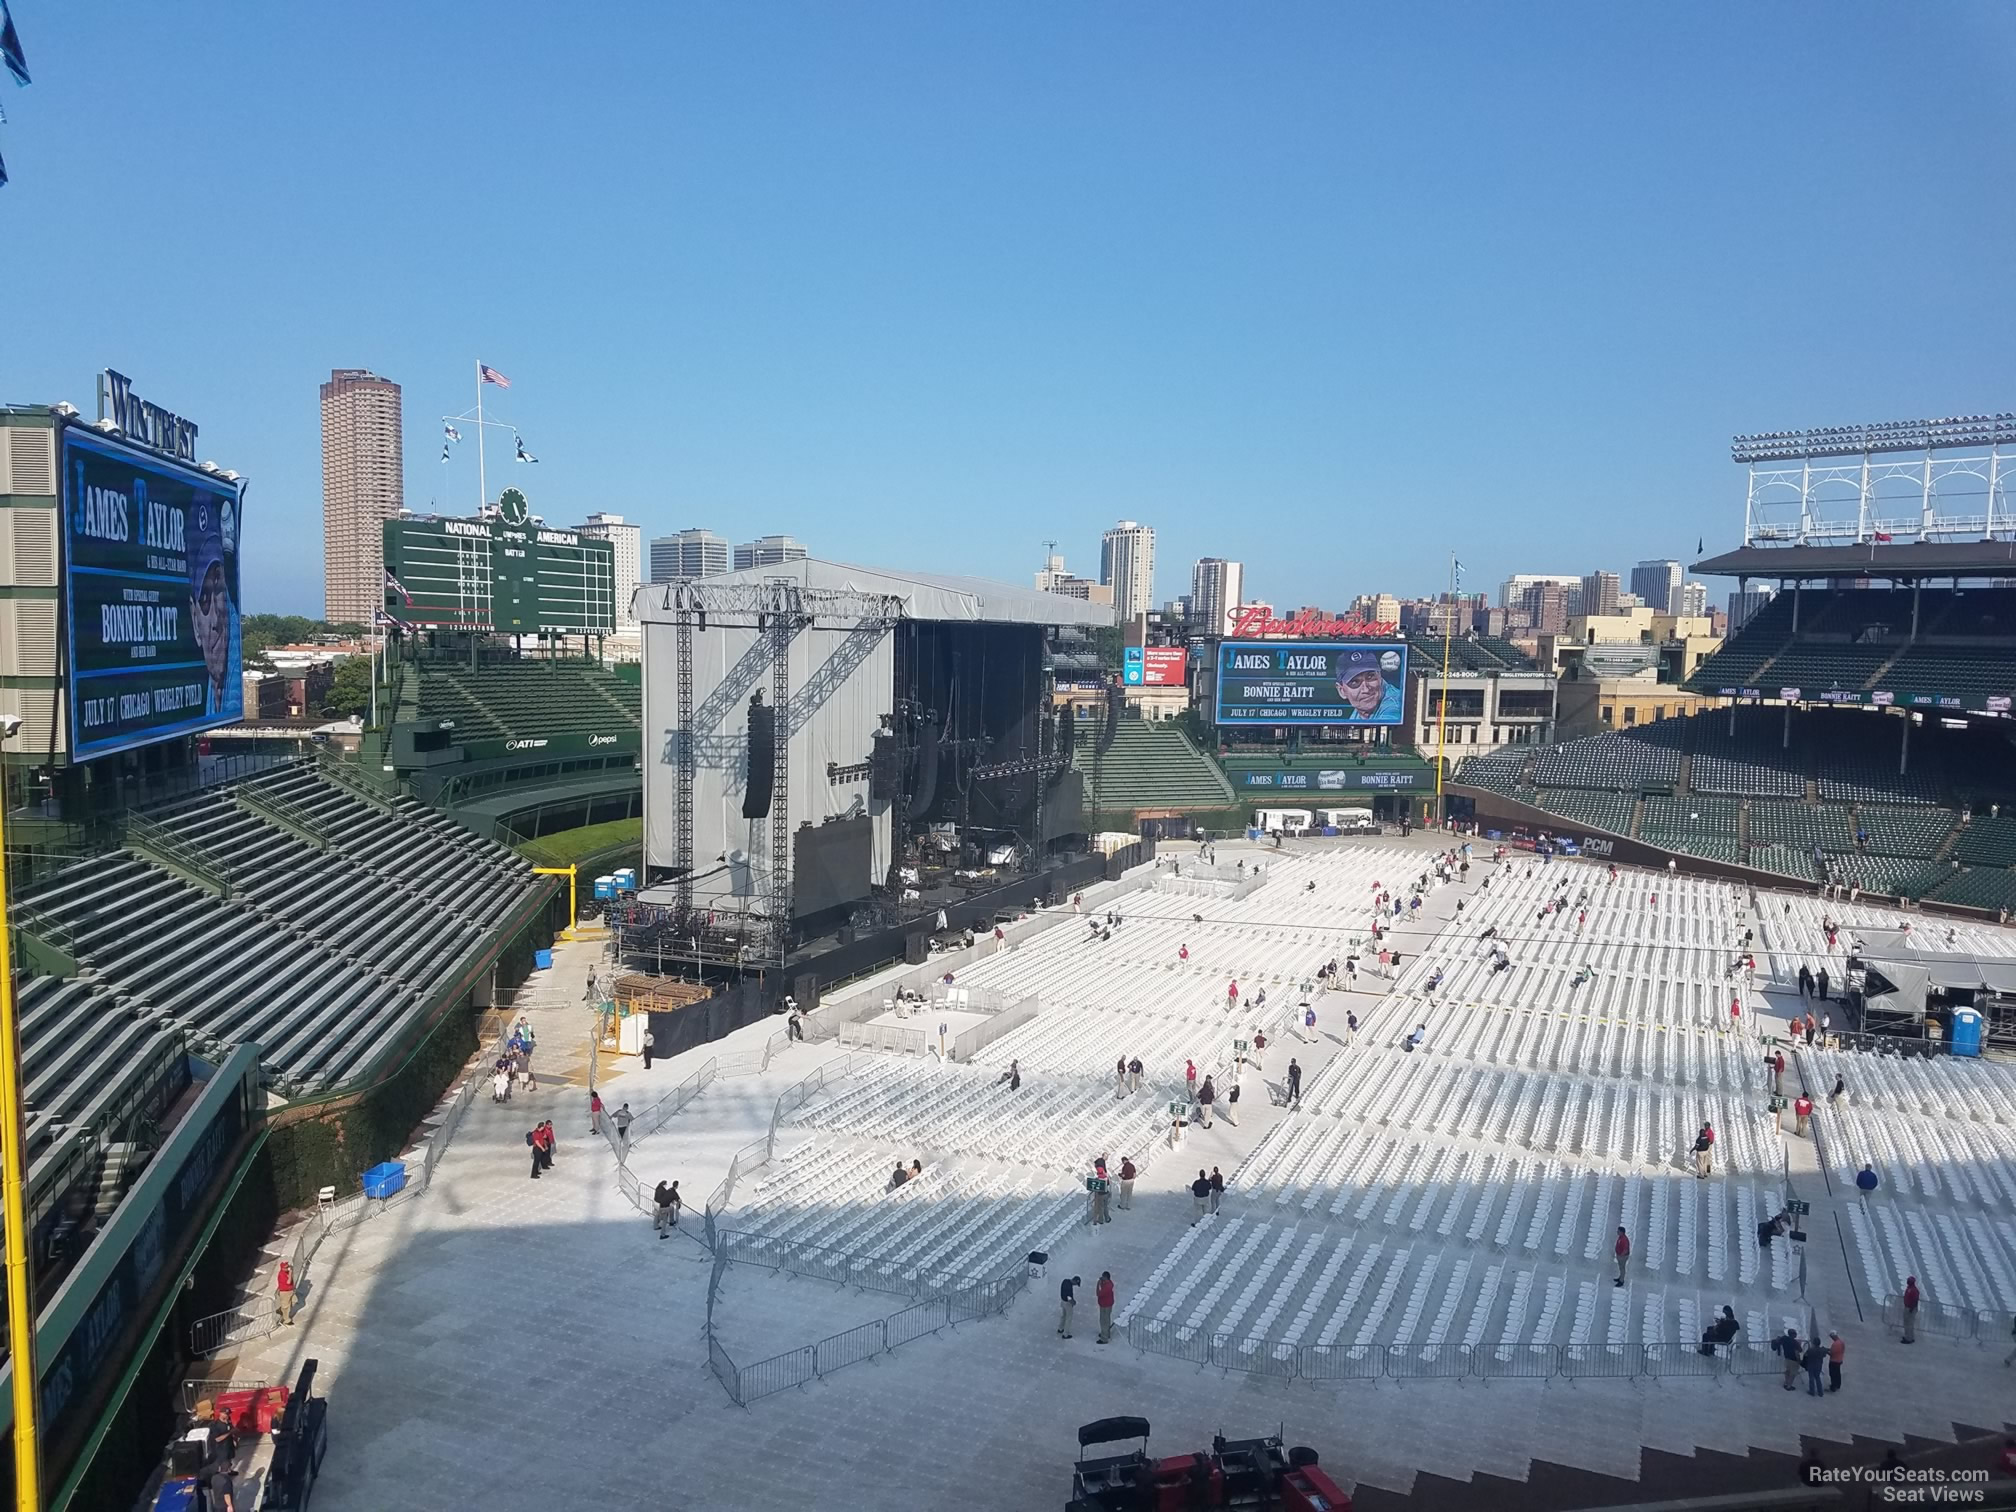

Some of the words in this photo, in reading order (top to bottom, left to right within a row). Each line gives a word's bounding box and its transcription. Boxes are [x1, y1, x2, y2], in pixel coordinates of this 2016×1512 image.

[104, 367, 198, 462] WINTRUST
[74, 459, 128, 542] JAMES
[134, 478, 185, 552] TAYLOR
[445, 521, 492, 537] NATIONAL
[537, 531, 578, 545] AMERICAN
[505, 549, 525, 558] BATTER
[159, 556, 176, 571] ALL-STAR
[134, 589, 148, 602] SPECIAL
[101, 604, 144, 643] BONNIE
[147, 606, 178, 641] RAITT
[1227, 606, 1398, 637] Budweiser
[1226, 649, 1270, 669] JAMES
[1276, 650, 1327, 670] TAYLOR
[1243, 686, 1280, 698] BONNIE
[1283, 686, 1315, 698] RAITT
[1718, 686, 1736, 694] JAMES
[1738, 686, 1760, 696] TAYLOR
[1820, 692, 1842, 700] BONNIE
[1843, 693, 1861, 701] RAITT
[84, 699, 105, 728] JULY
[107, 697, 115, 722] 17
[120, 692, 150, 720] CHICAGO
[153, 686, 184, 713] WRIGLEY
[185, 684, 202, 708] FIELD
[1911, 693, 1932, 704] JAMES
[1935, 694, 1961, 705] TAYLOR
[1230, 709, 1248, 717] JULY
[1248, 709, 1256, 717] 17
[1260, 709, 1287, 717] CHICAGO
[1291, 709, 1321, 717] WRIGLEY
[1323, 709, 1343, 717] FIELD
[516, 740, 533, 748] ATI
[598, 735, 617, 746] pepsi
[1245, 770, 1273, 785] JAMES
[1276, 770, 1307, 785] TAYLOR
[1361, 775, 1388, 784] BONNIE
[1390, 775, 1413, 784] RAITT
[1582, 837, 1614, 853] PCM
